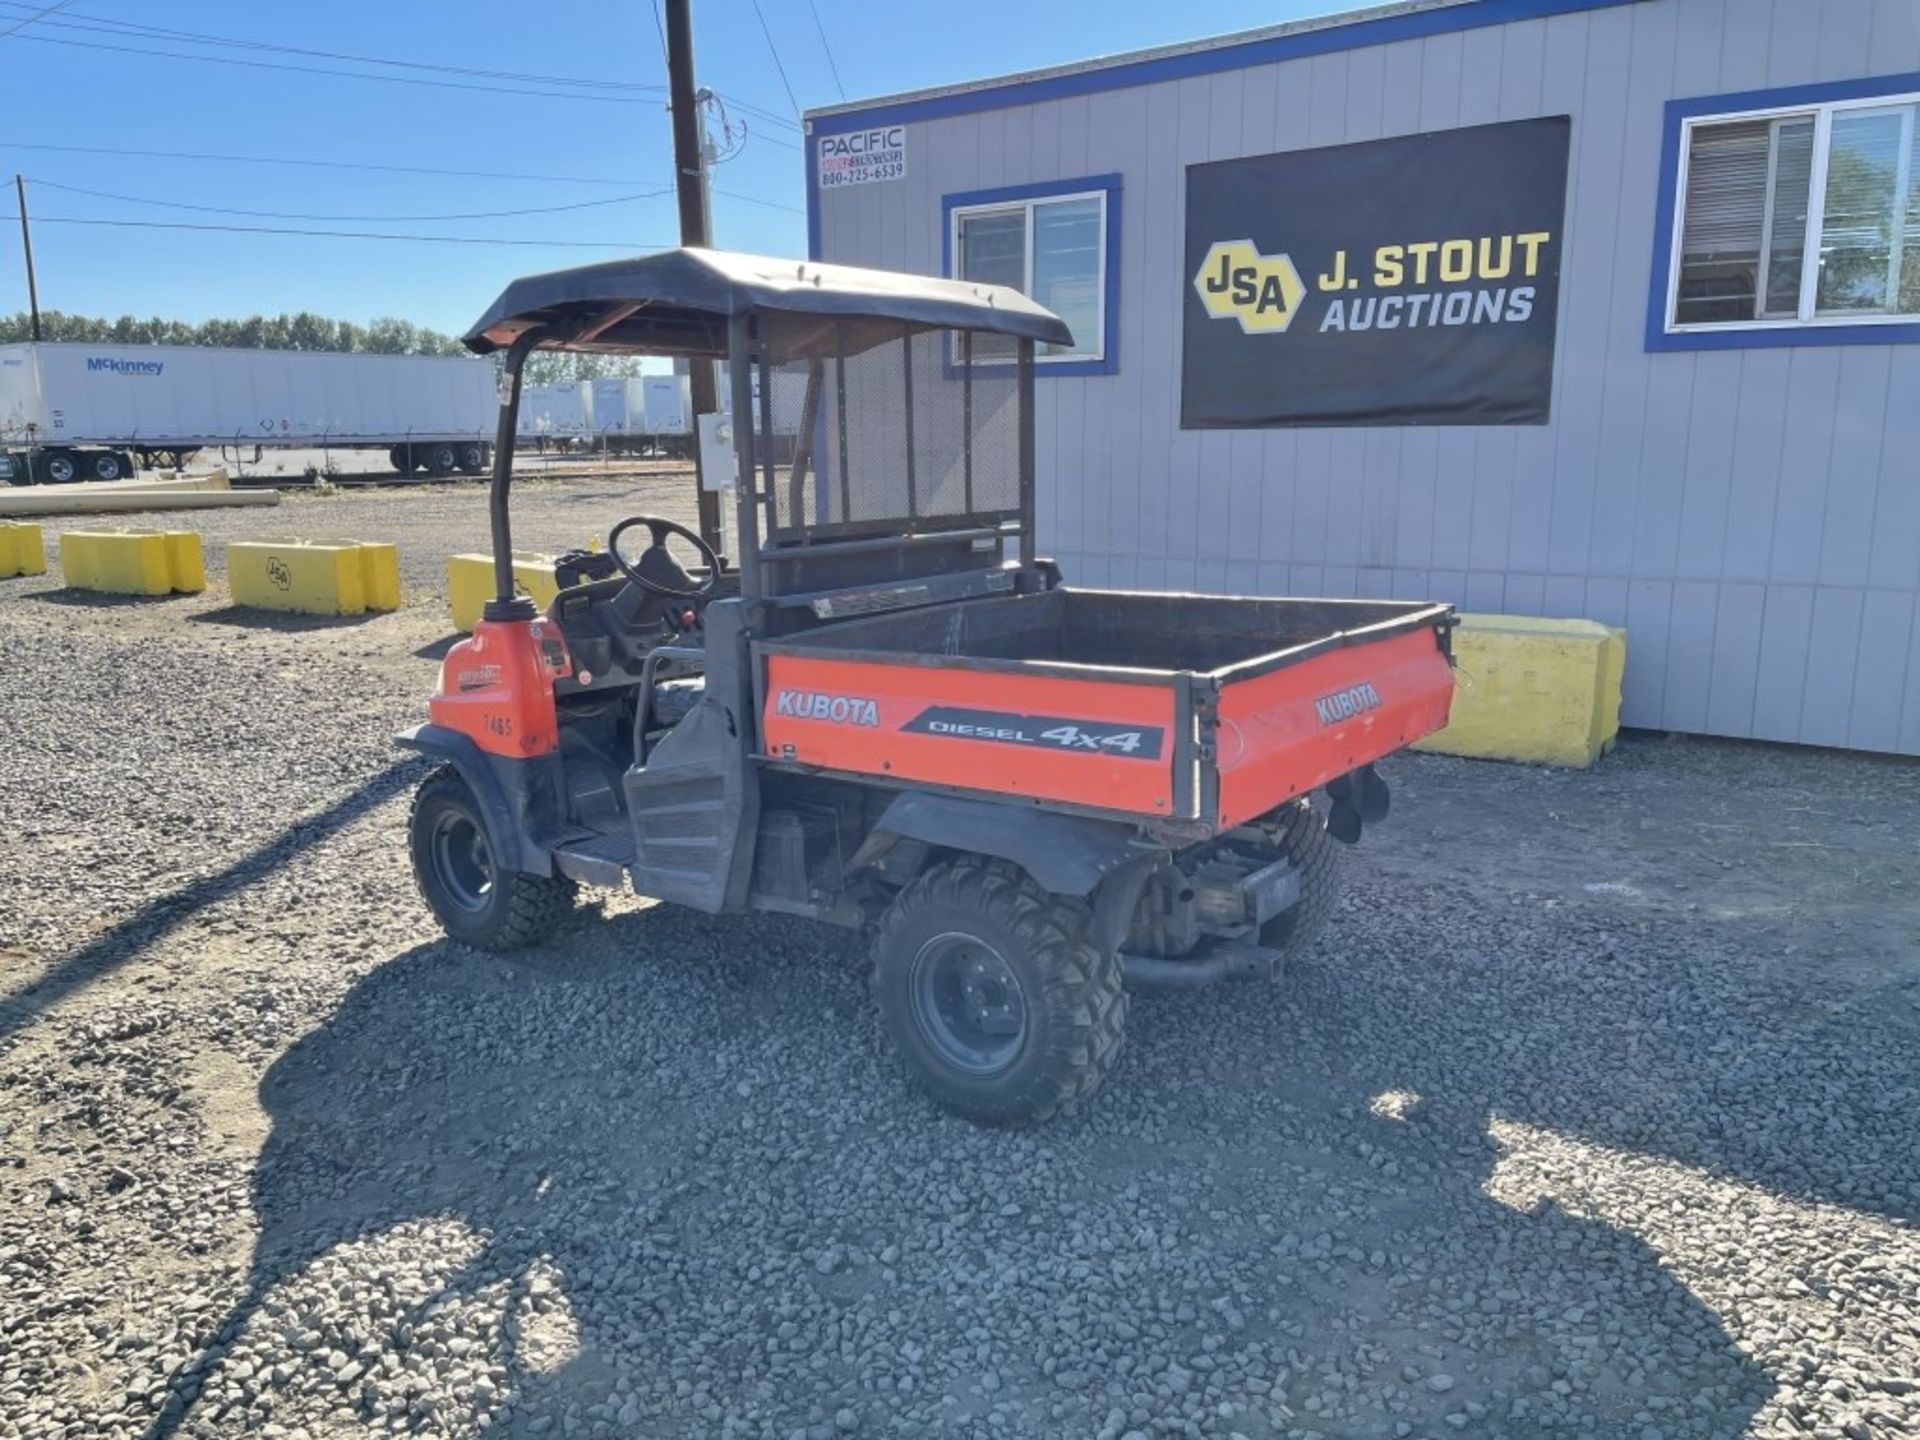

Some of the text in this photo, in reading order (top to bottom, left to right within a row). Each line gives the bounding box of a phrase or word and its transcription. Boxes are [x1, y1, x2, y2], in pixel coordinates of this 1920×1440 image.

[822, 163, 903, 186] 800-225-6539
[1318, 232, 1550, 291] J. STOUT
[1206, 254, 1287, 314] JSA
[1319, 286, 1536, 333] AUCTIONS
[776, 690, 879, 726] KUBOTA
[1315, 682, 1381, 726] KUBOTA
[928, 720, 1143, 753] DIESEL 4x4
